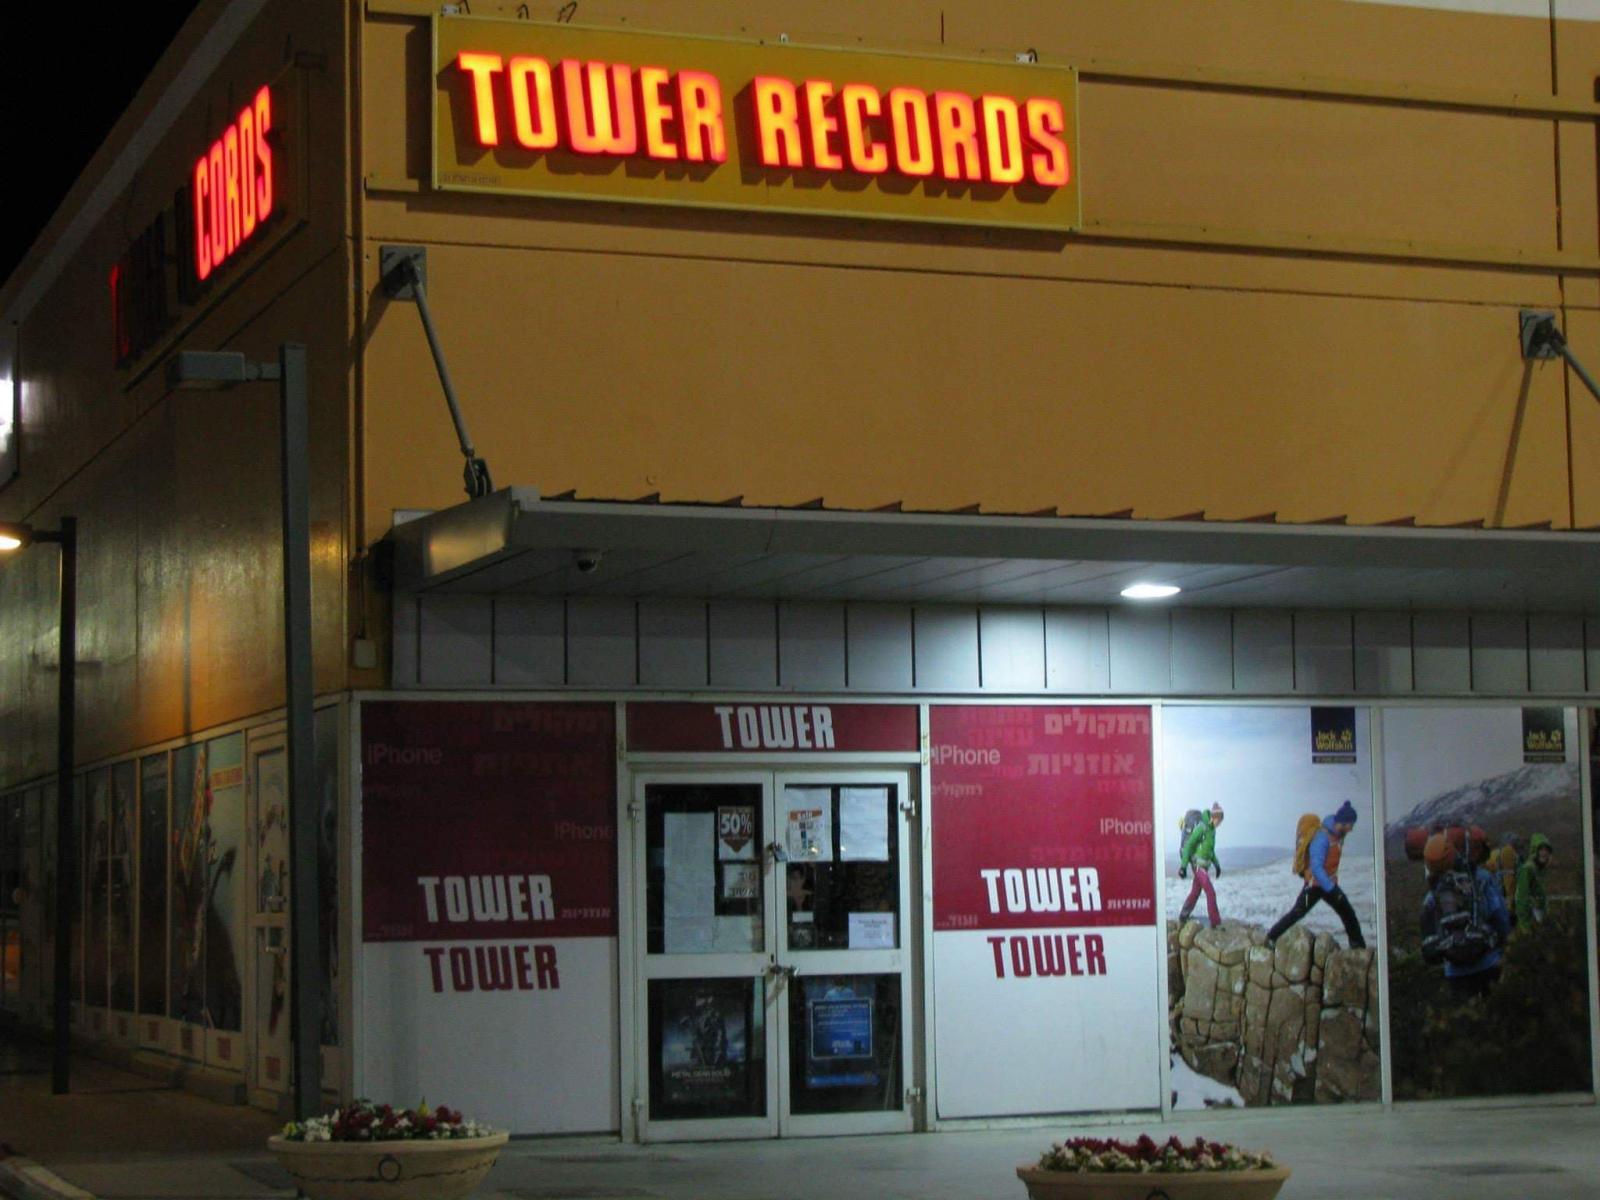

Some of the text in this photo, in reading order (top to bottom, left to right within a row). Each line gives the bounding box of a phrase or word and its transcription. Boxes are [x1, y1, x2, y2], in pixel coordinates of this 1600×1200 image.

[457, 52, 1070, 187] TOWER RECORDS
[713, 705, 836, 750] TOWER
[1043, 707, 1150, 740] רמקולים
[1026, 752, 1136, 776] אוזניות
[720, 813, 752, 834] 50%
[417, 874, 555, 924] TOWER
[980, 866, 1103, 914] TOWER
[424, 943, 560, 991] TOWER
[986, 933, 1108, 980] TOWER
